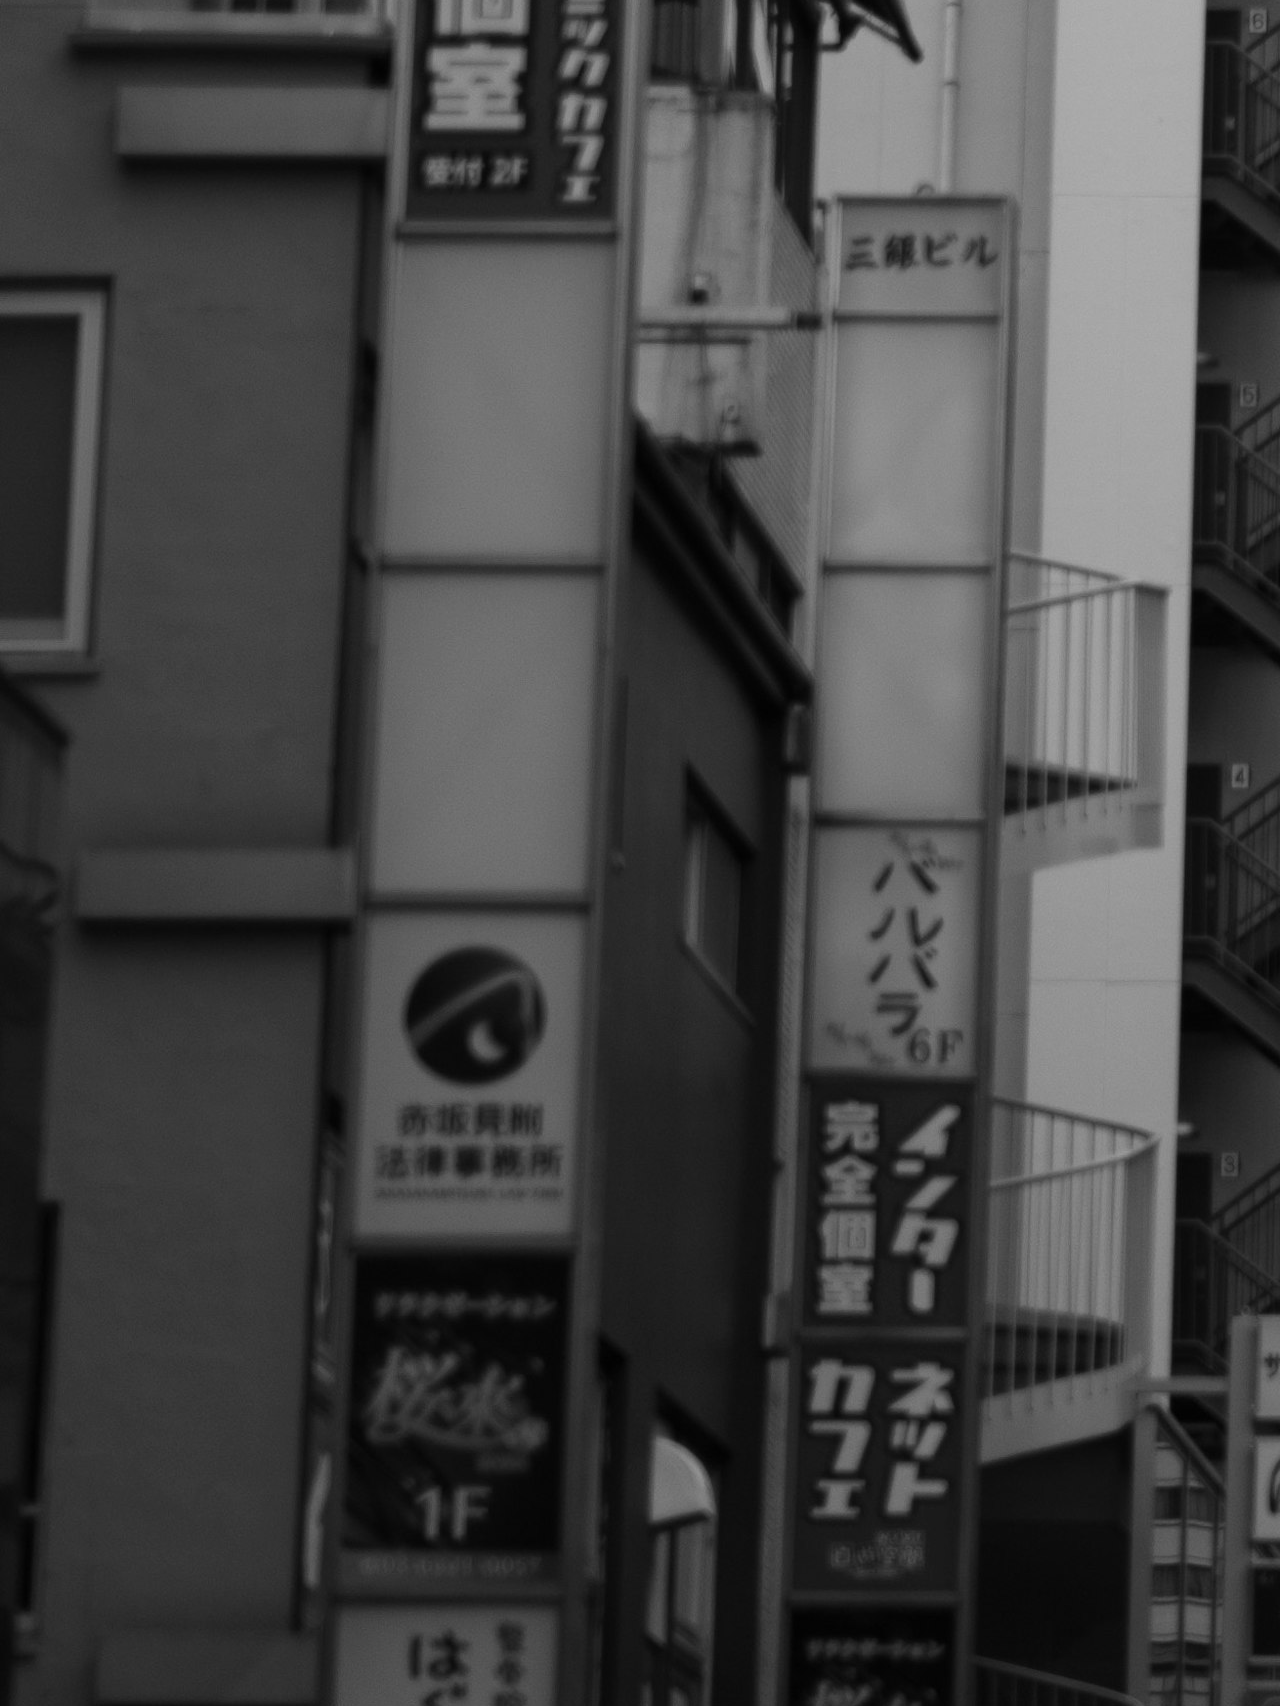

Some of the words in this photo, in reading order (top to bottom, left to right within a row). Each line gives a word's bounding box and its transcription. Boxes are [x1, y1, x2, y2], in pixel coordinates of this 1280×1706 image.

[1253, 12, 1264, 30] 6
[491, 157, 529, 186] 2F
[845, 231, 999, 270] 三銀ビル
[1236, 766, 1246, 784] 4
[907, 1026, 963, 1064] 6F
[374, 1145, 562, 1179] 法律事務所
[1225, 1155, 1235, 1173] 3
[816, 1099, 879, 1314] 完全個室
[809, 1359, 876, 1518] カフェ
[414, 1486, 492, 1541] 1F
